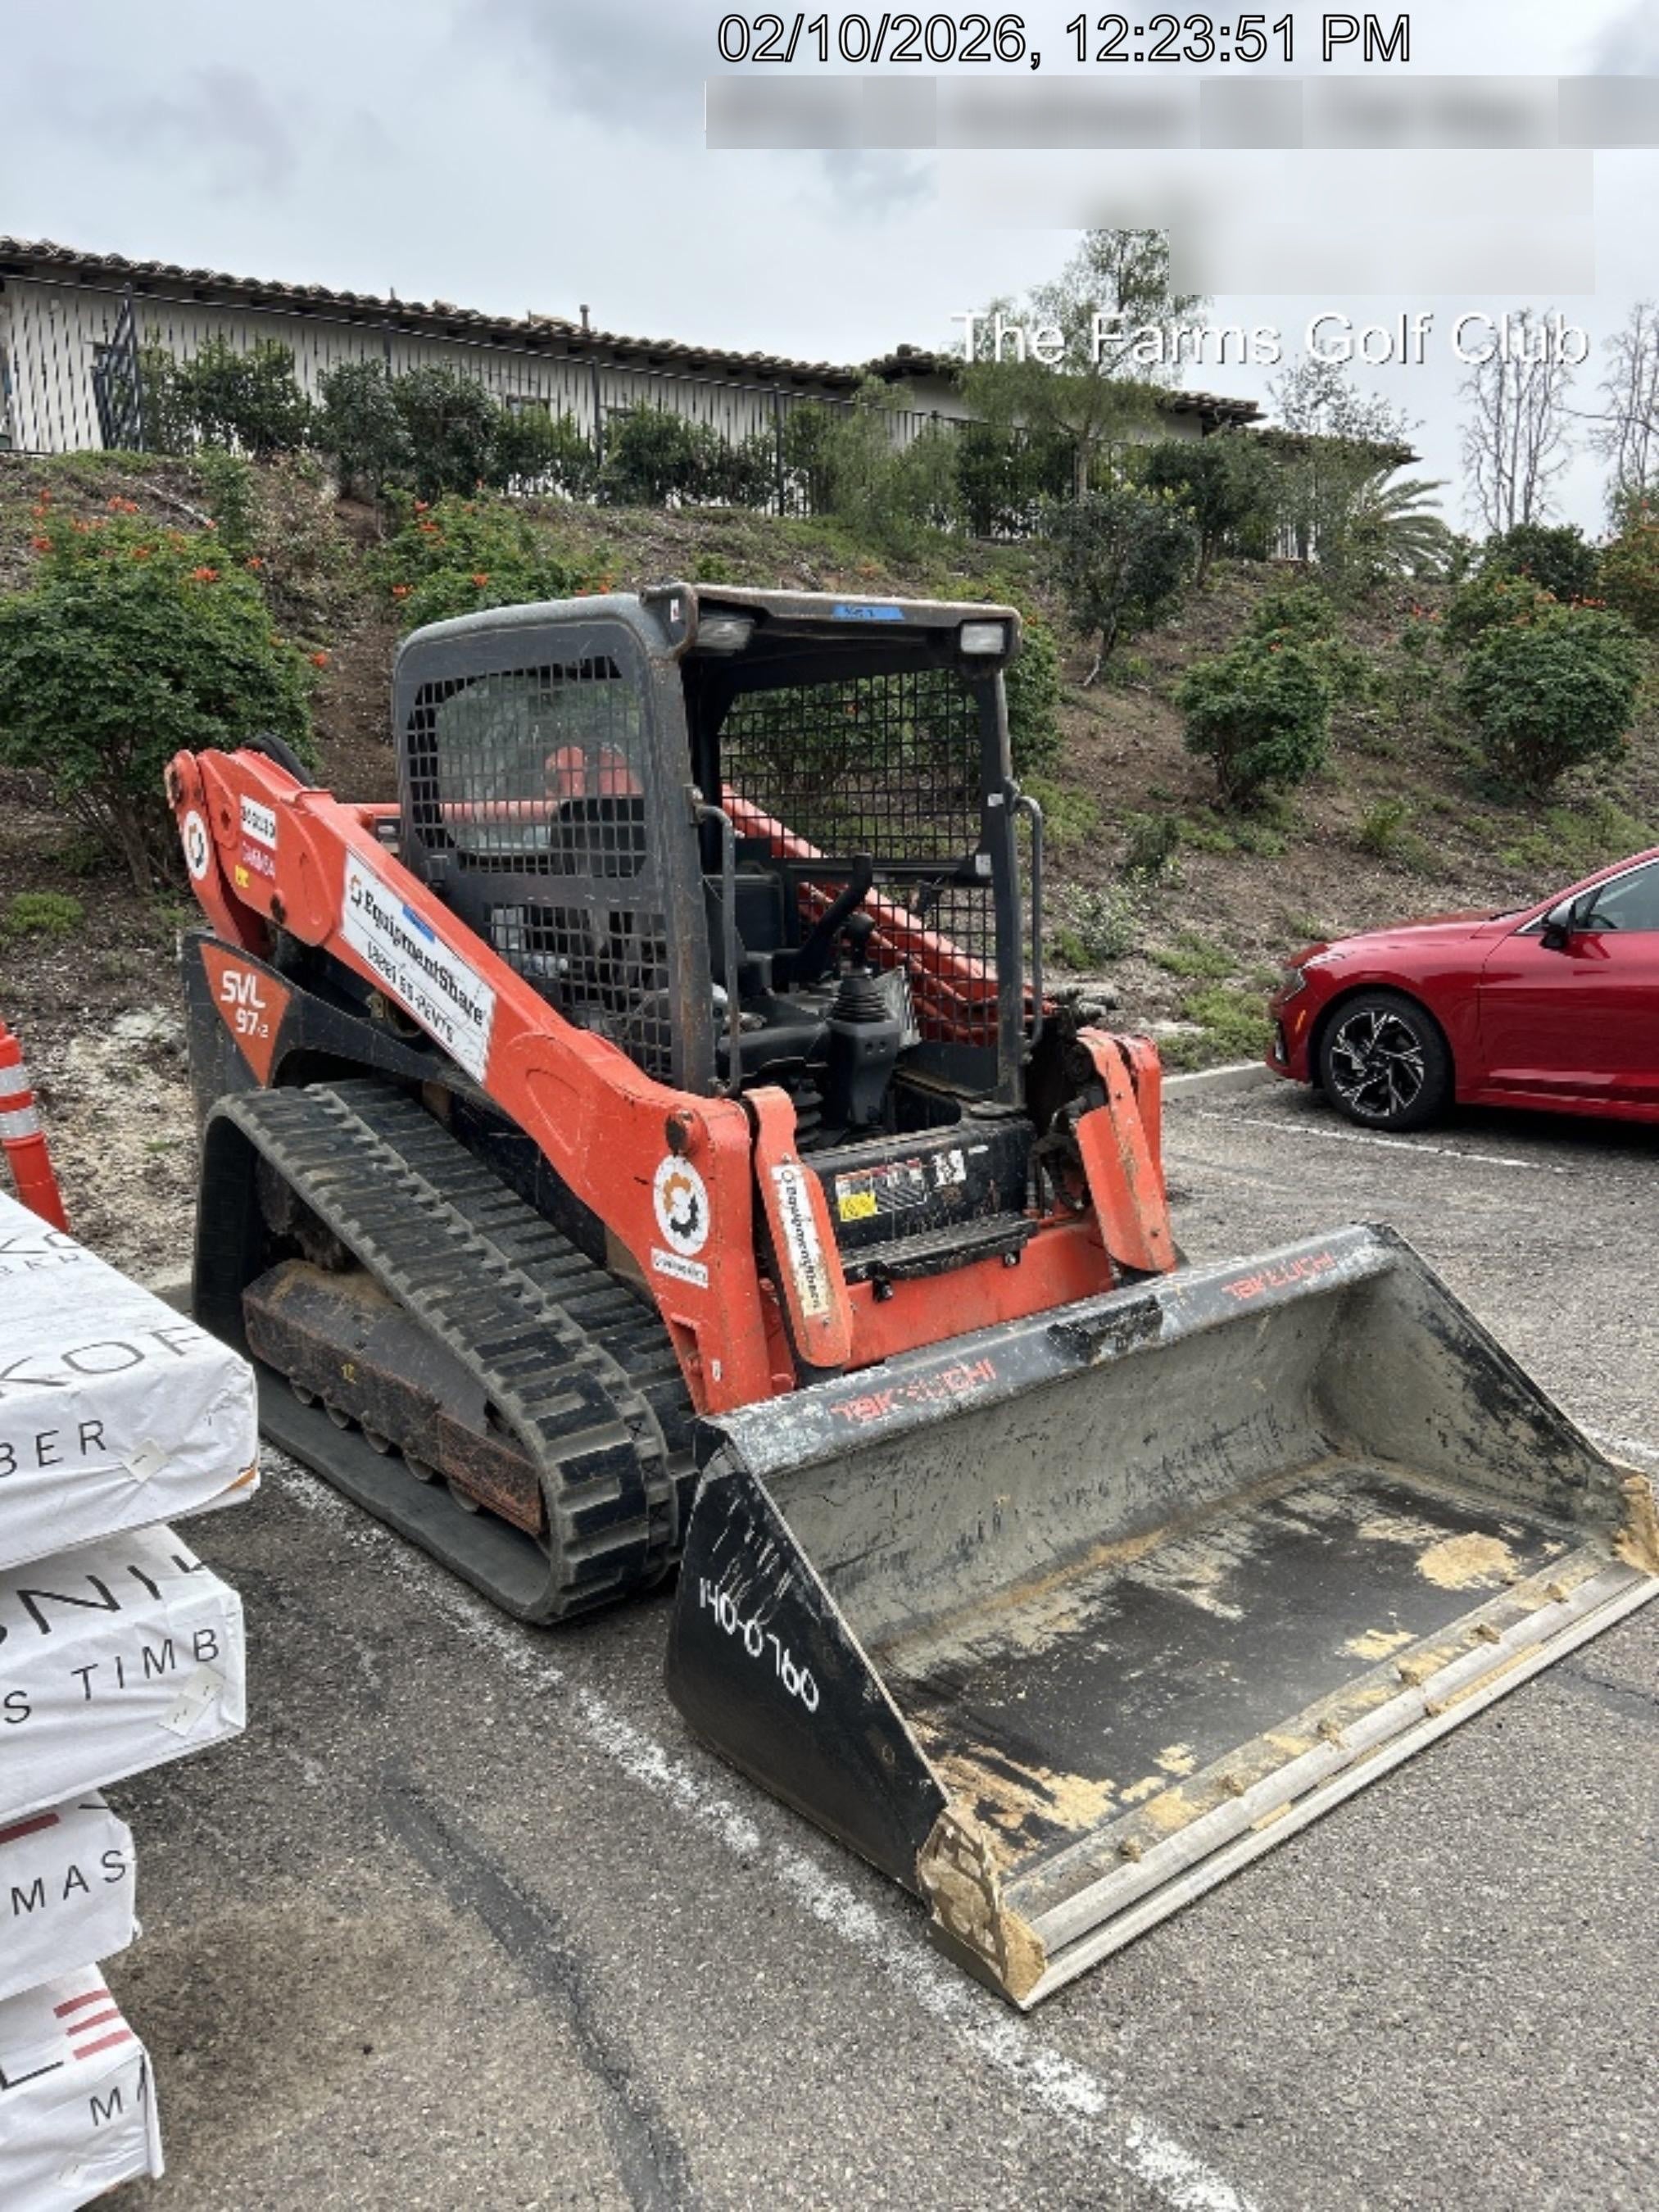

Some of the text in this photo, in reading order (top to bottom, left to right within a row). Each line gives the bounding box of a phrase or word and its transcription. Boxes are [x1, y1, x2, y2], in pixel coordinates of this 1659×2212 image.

[220, 970, 266, 1009] SVL
[364, 890, 487, 1027] EquipmentShare
[70, 1629, 220, 1701] TIMB
[699, 1577, 819, 1712] 140-0760
[11, 1850, 126, 1916] MAS
